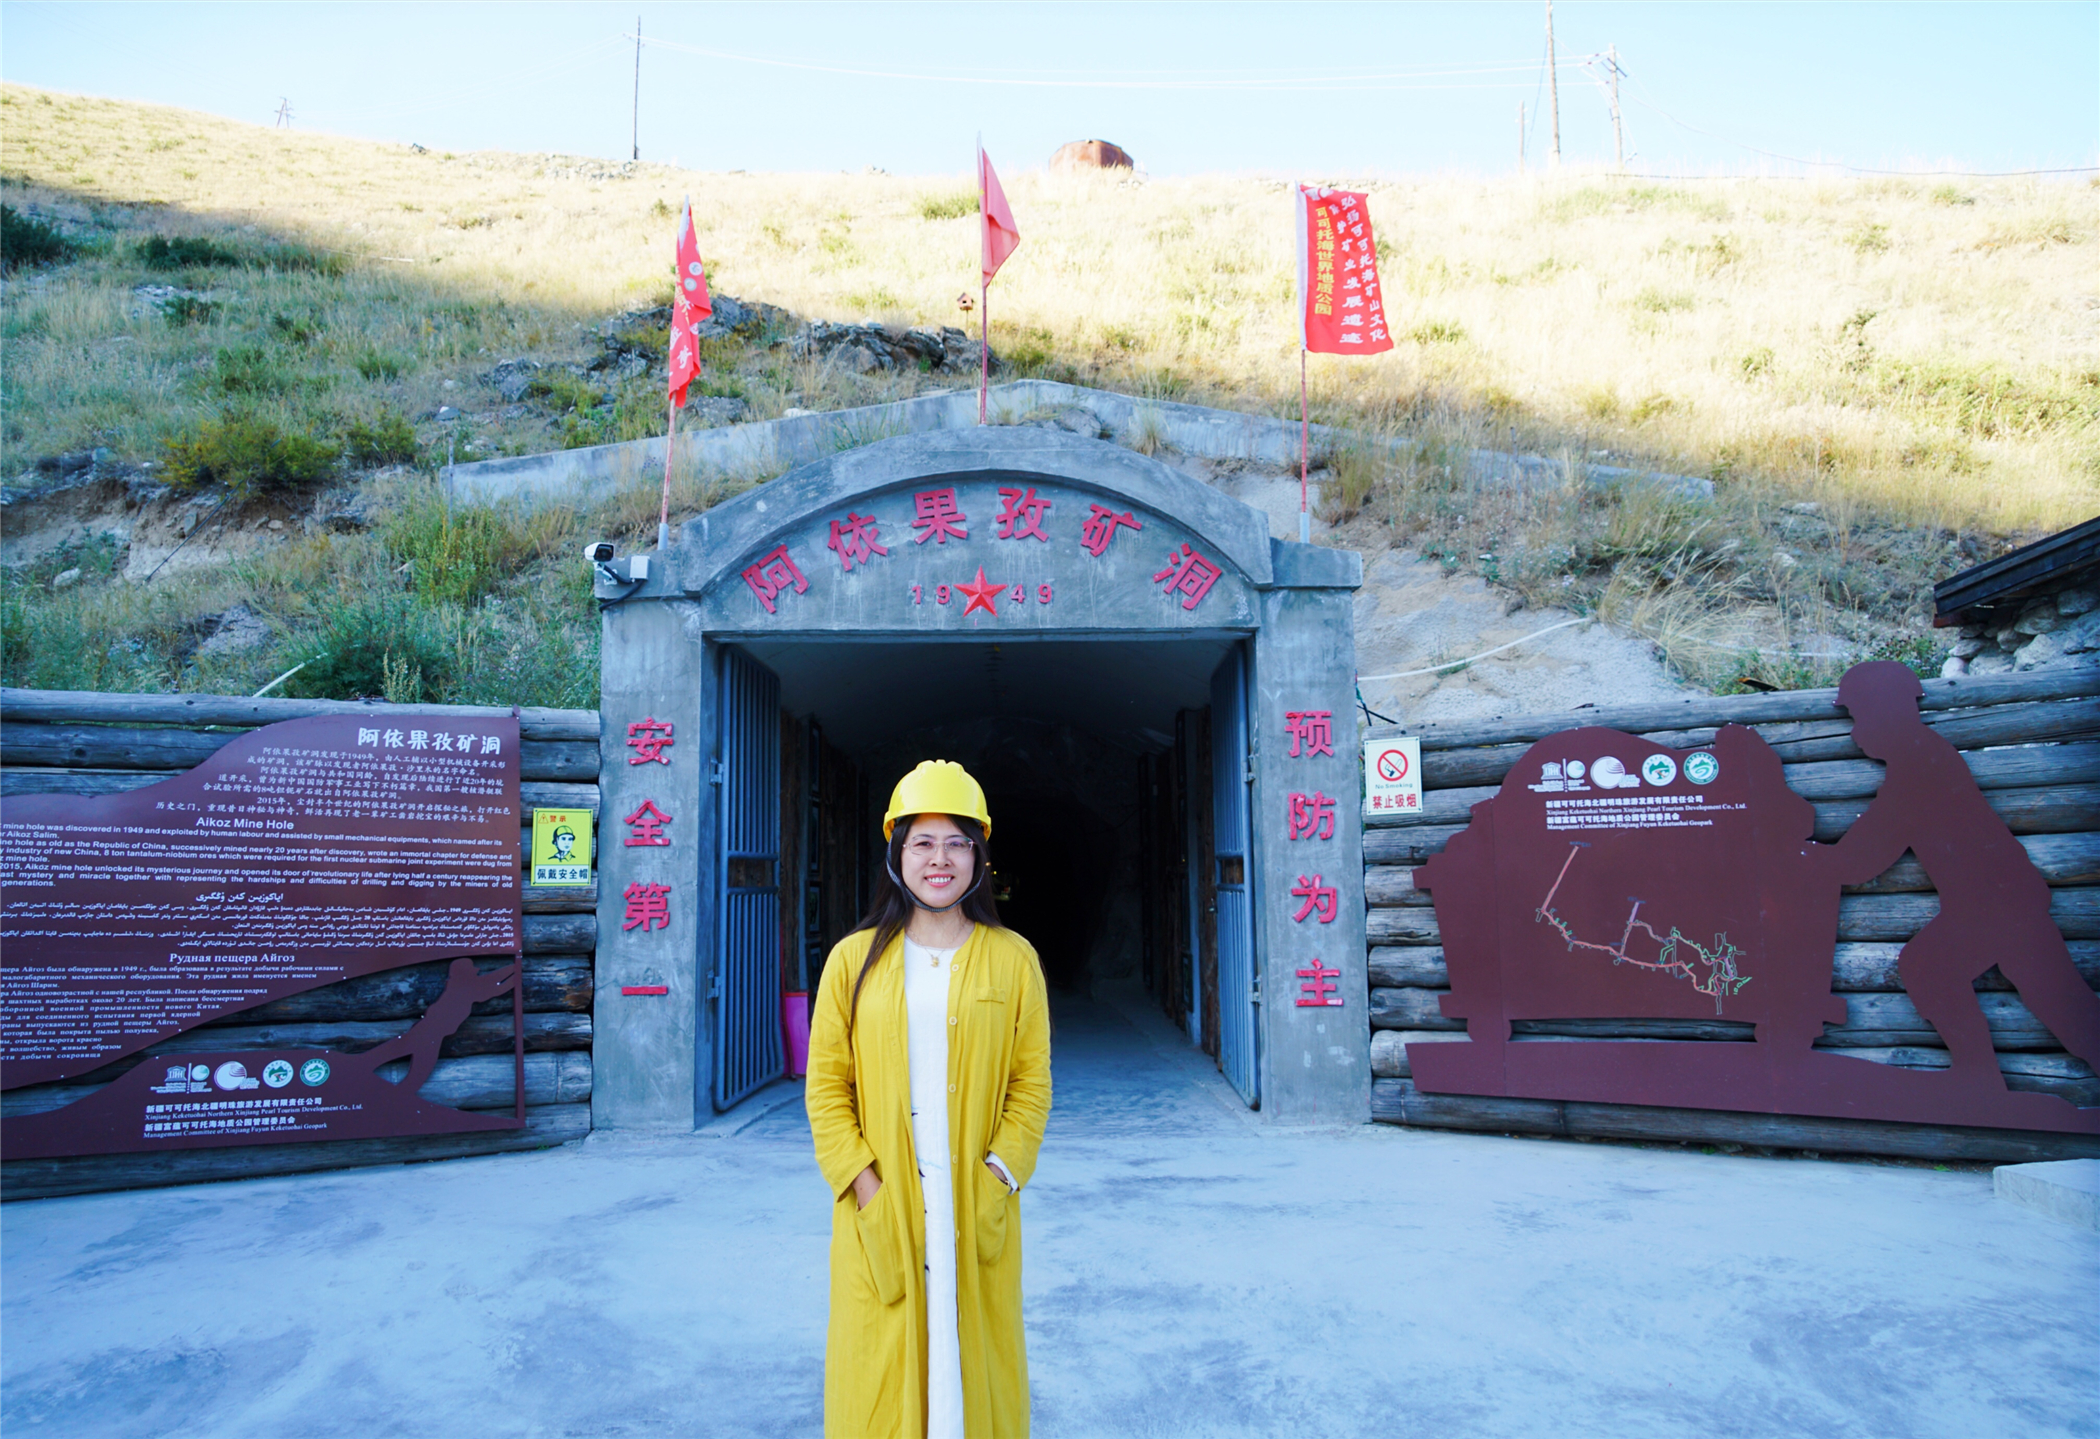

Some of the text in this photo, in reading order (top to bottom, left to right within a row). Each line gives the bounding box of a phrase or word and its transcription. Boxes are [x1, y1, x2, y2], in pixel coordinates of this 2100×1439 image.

[1315, 206, 1335, 316] 可可托海世界地质公园
[741, 487, 1222, 613] 阿依果孜矿洞
[358, 728, 500, 754] 阿依果孜矿洞
[1373, 794, 1416, 809] 禁止吸烟
[196, 817, 294, 830] Aikoz Mine Hole
[550, 815, 566, 823] 警示
[26, 823, 45, 832] hole
[622, 716, 674, 996] 安全第一
[1284, 710, 1344, 1006] 预防为主
[19, 872, 54, 882] mystery
[248, 876, 286, 884] hardships
[537, 868, 588, 880] 佩戴安全帽
[170, 953, 295, 964] Рудная пещера Айгоз
